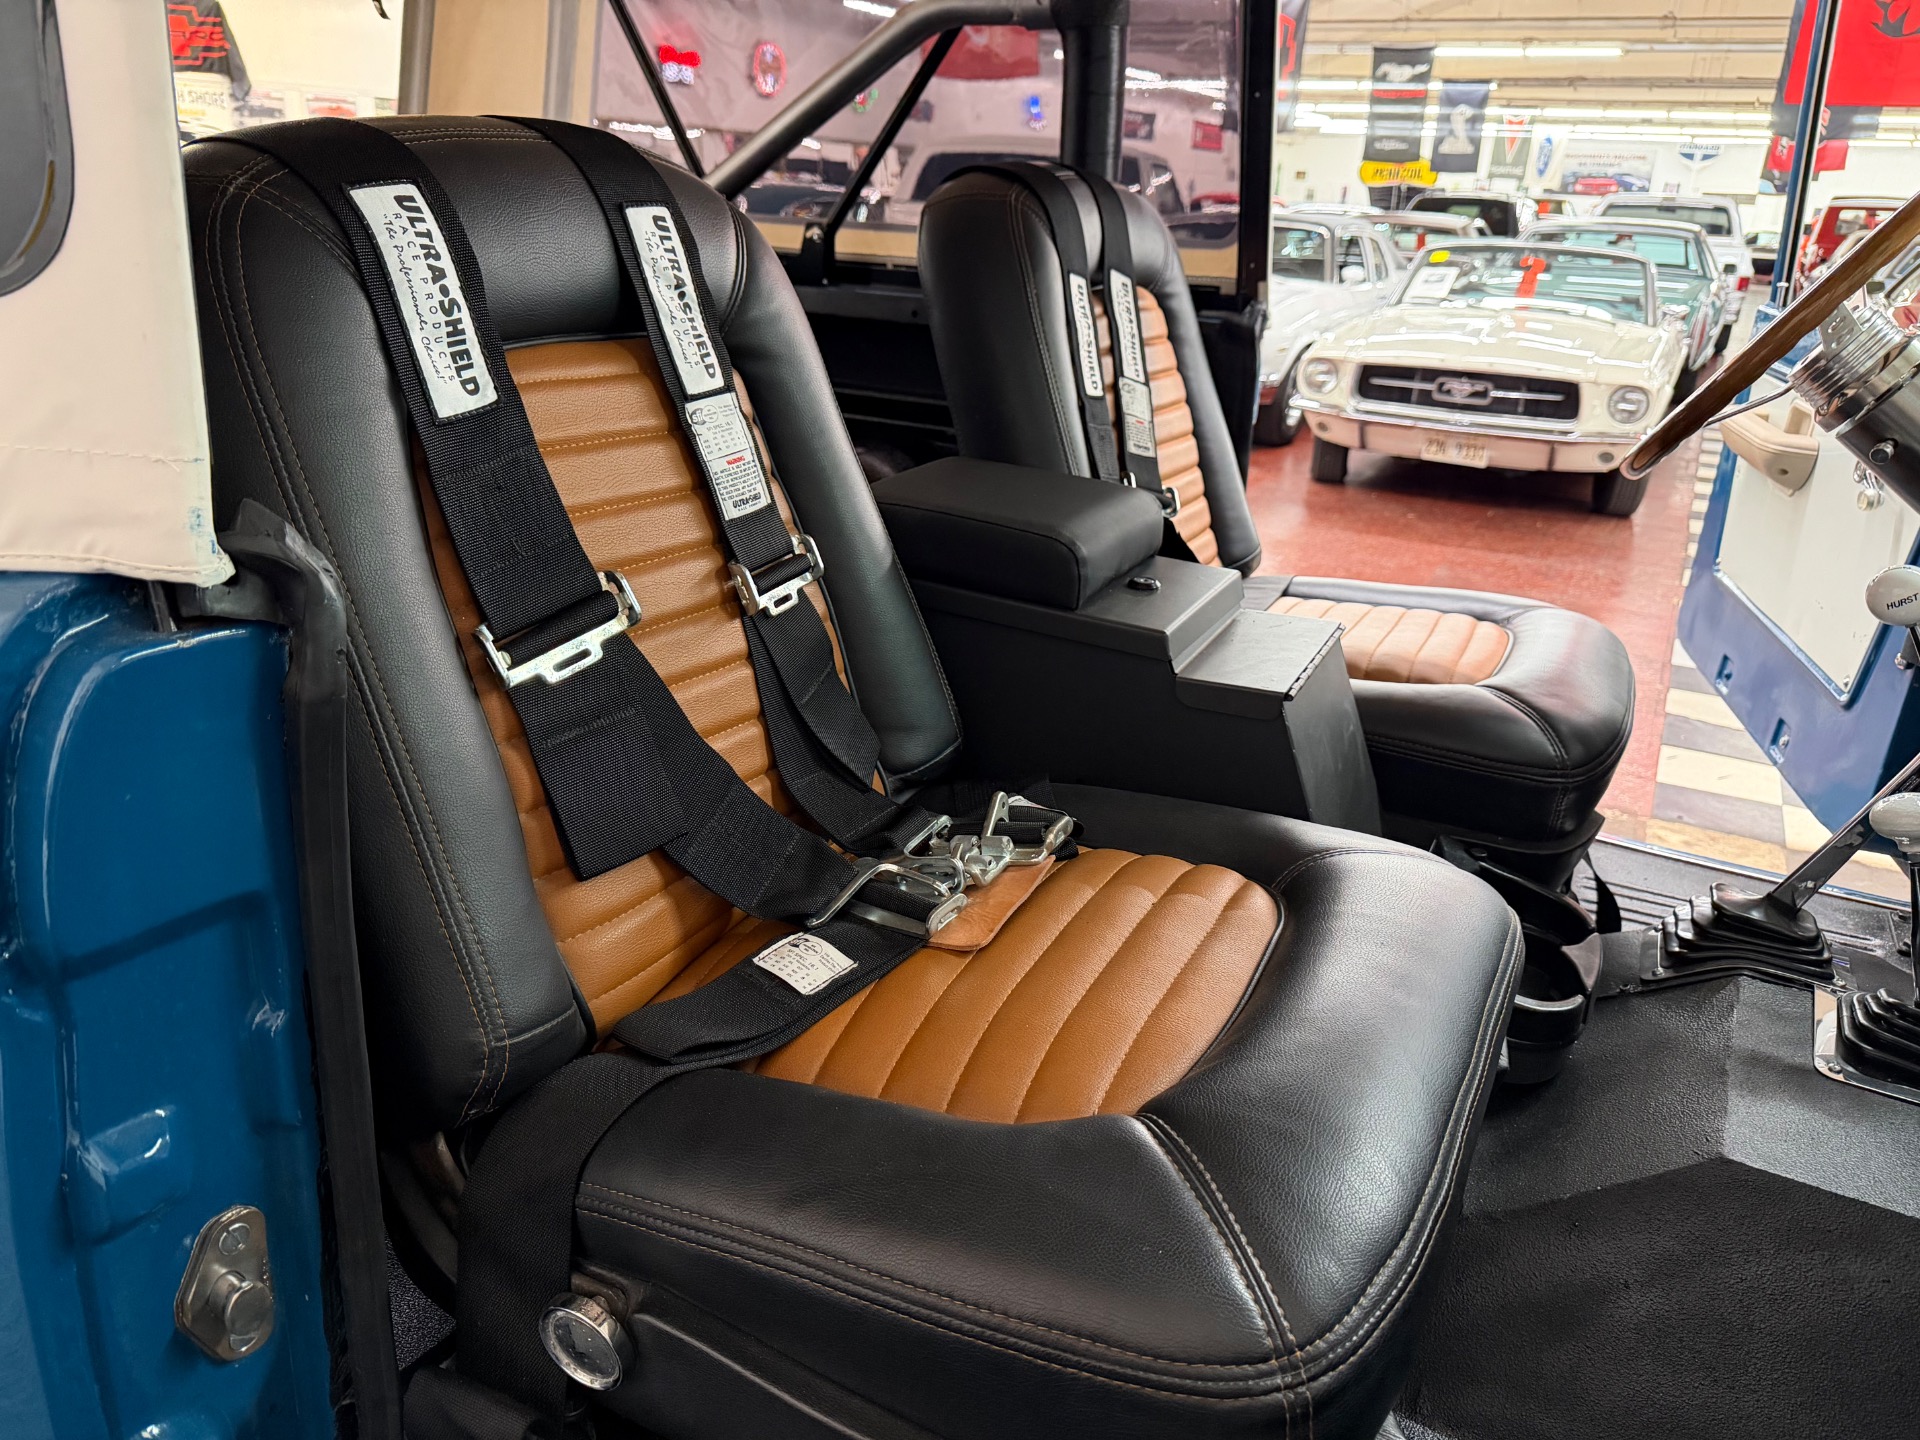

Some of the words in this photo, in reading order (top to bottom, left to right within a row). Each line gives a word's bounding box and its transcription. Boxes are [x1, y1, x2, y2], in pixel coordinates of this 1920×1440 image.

[392, 212, 421, 261] RACE
[420, 277, 455, 382] PRODUCTS
[650, 231, 670, 272] RACE
[665, 284, 700, 366] PRODUCTS
[1886, 592, 1919, 610] HURST
